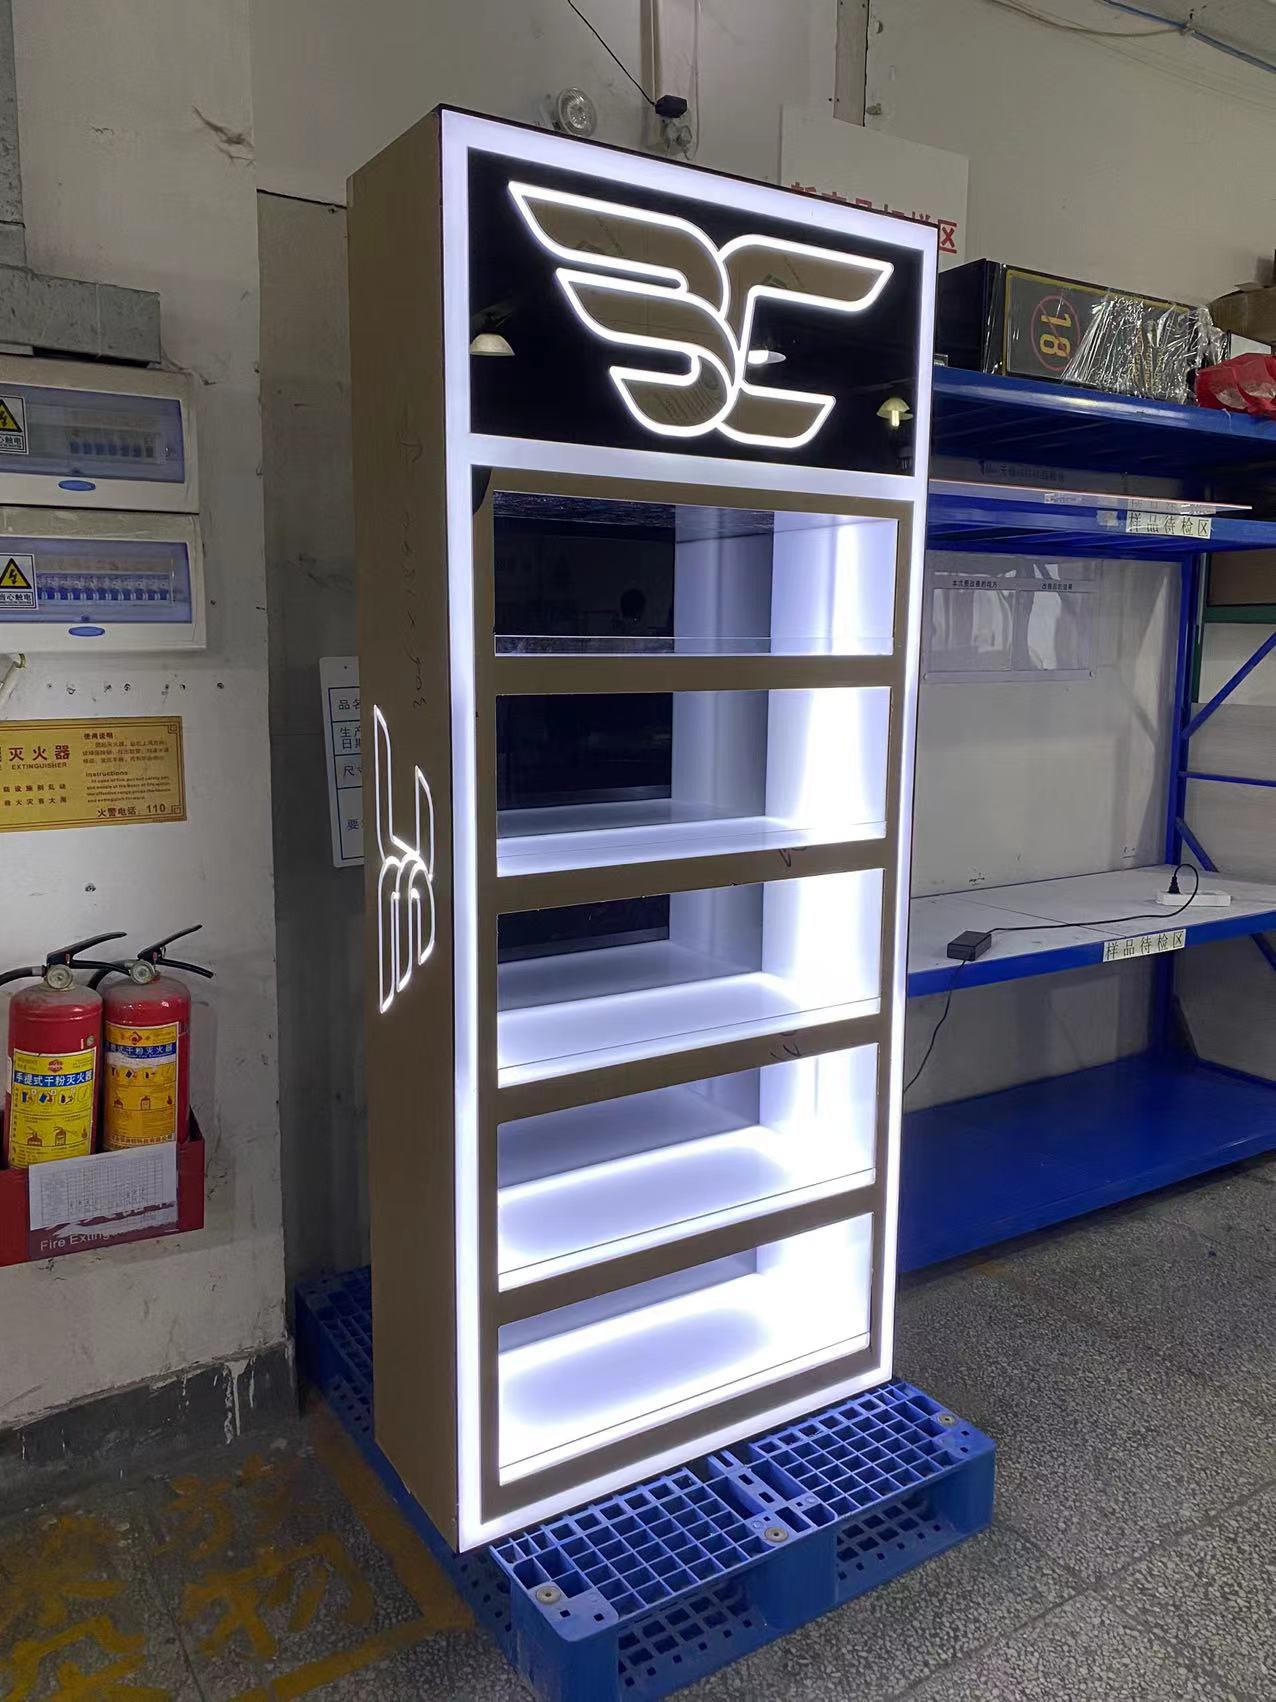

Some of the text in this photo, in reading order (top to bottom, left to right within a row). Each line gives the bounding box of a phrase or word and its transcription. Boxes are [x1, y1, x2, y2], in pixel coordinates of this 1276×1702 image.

[1040, 313, 1073, 358] 18
[1129, 512, 1209, 537] 样品待检区
[0, 745, 70, 761] 灭火器
[12, 762, 67, 770] EXTINGUISHER
[147, 803, 166, 813] 110
[1106, 931, 1183, 960] 样品待检区
[16, 1069, 93, 1086] 手提式干粉灭火器
[40, 1238, 65, 1252] Fire
